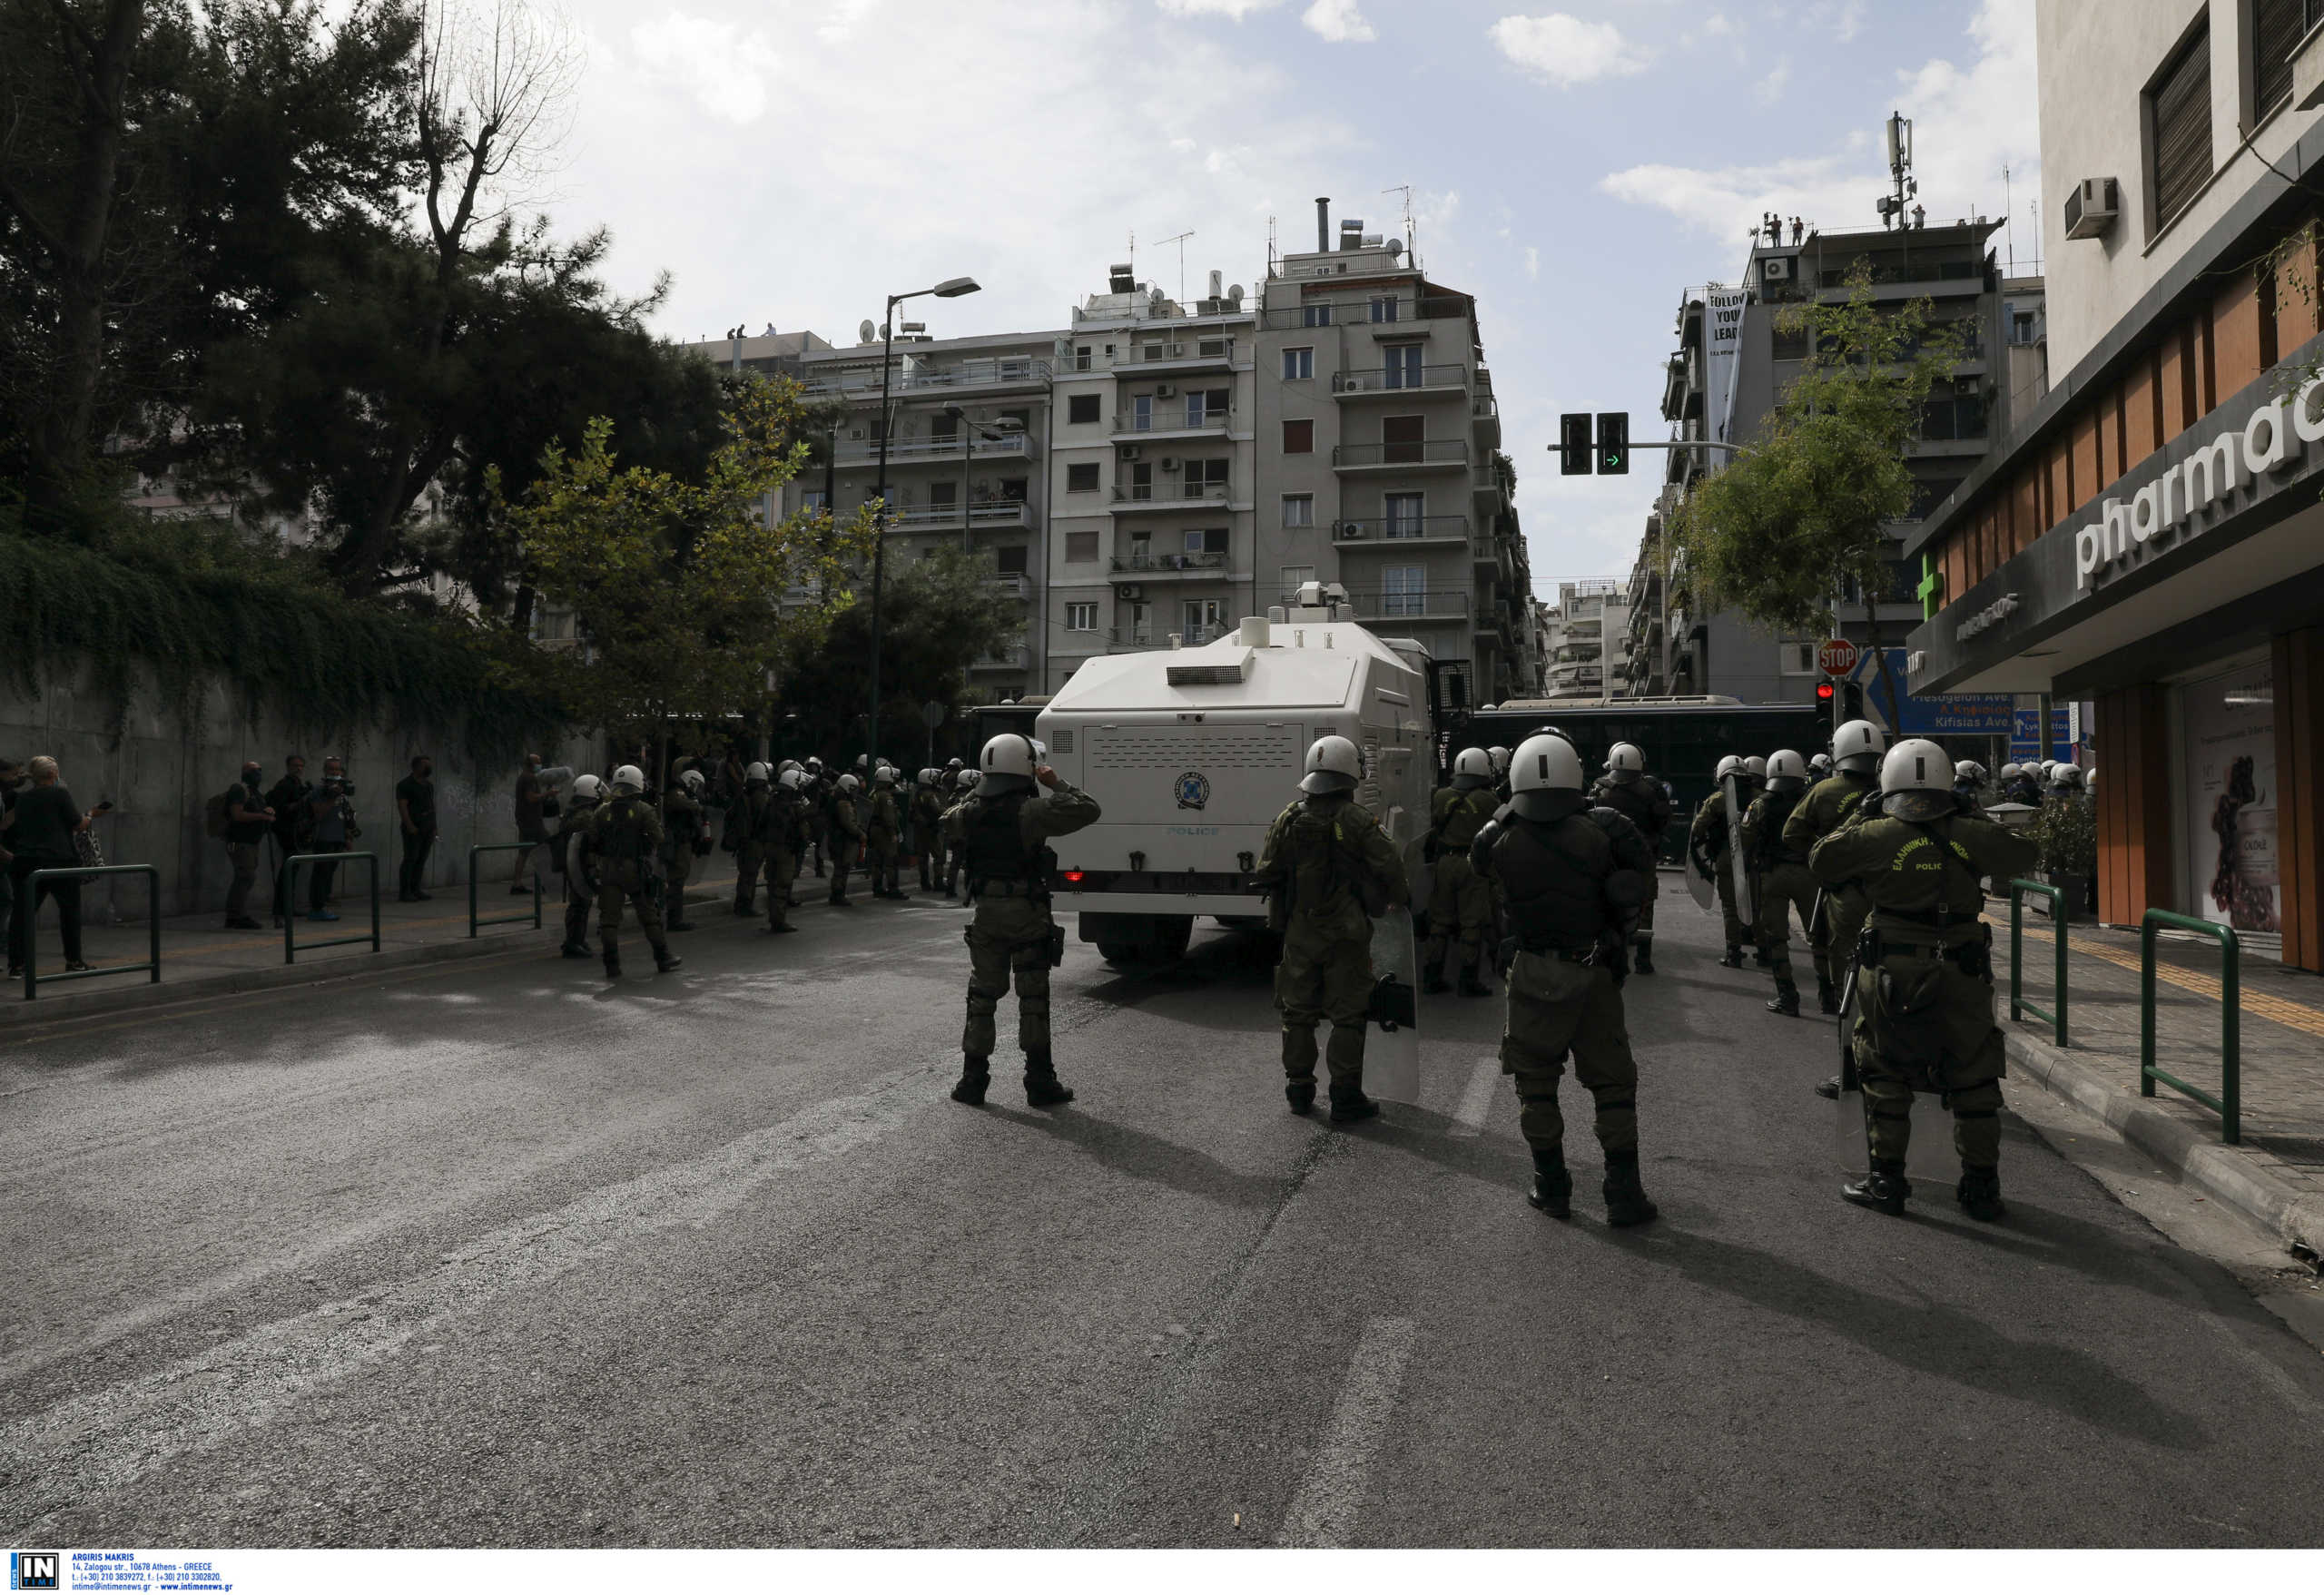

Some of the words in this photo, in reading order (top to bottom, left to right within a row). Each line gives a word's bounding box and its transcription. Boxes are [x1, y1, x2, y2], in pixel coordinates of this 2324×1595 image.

[1820, 647, 1854, 668] STOP
[1935, 716, 1981, 727] Kifisias
[1984, 716, 2012, 727] Ave.
[1167, 827, 1219, 836] POLICE
[1915, 863, 1943, 871] POLIC
